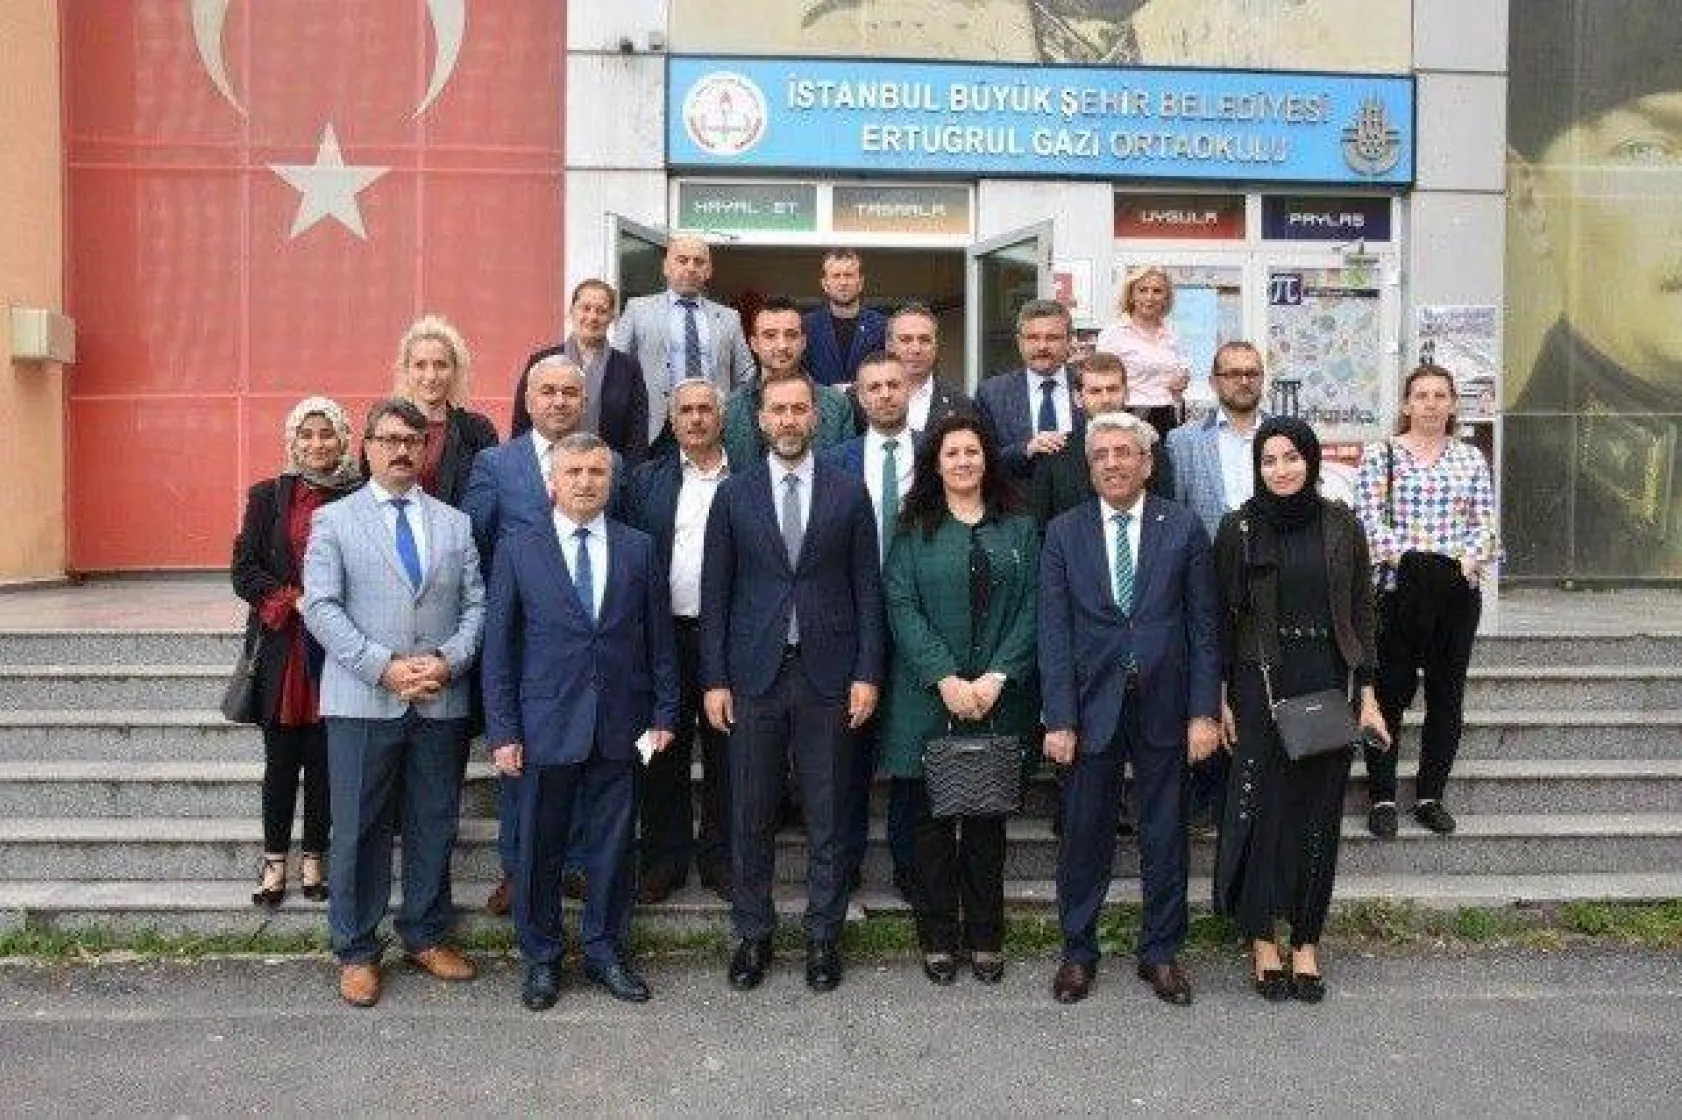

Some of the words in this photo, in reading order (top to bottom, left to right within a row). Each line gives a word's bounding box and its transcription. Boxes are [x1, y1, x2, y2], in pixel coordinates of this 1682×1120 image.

[787, 71, 940, 110] İSTANBUL
[949, 79, 1053, 113] BÜYÜK
[1060, 84, 1150, 123] ŞEHİR
[862, 118, 1026, 154] ERTUĞRUL
[1110, 131, 1288, 162] ORTAOKULU
[1141, 209, 1218, 224] UYGULA
